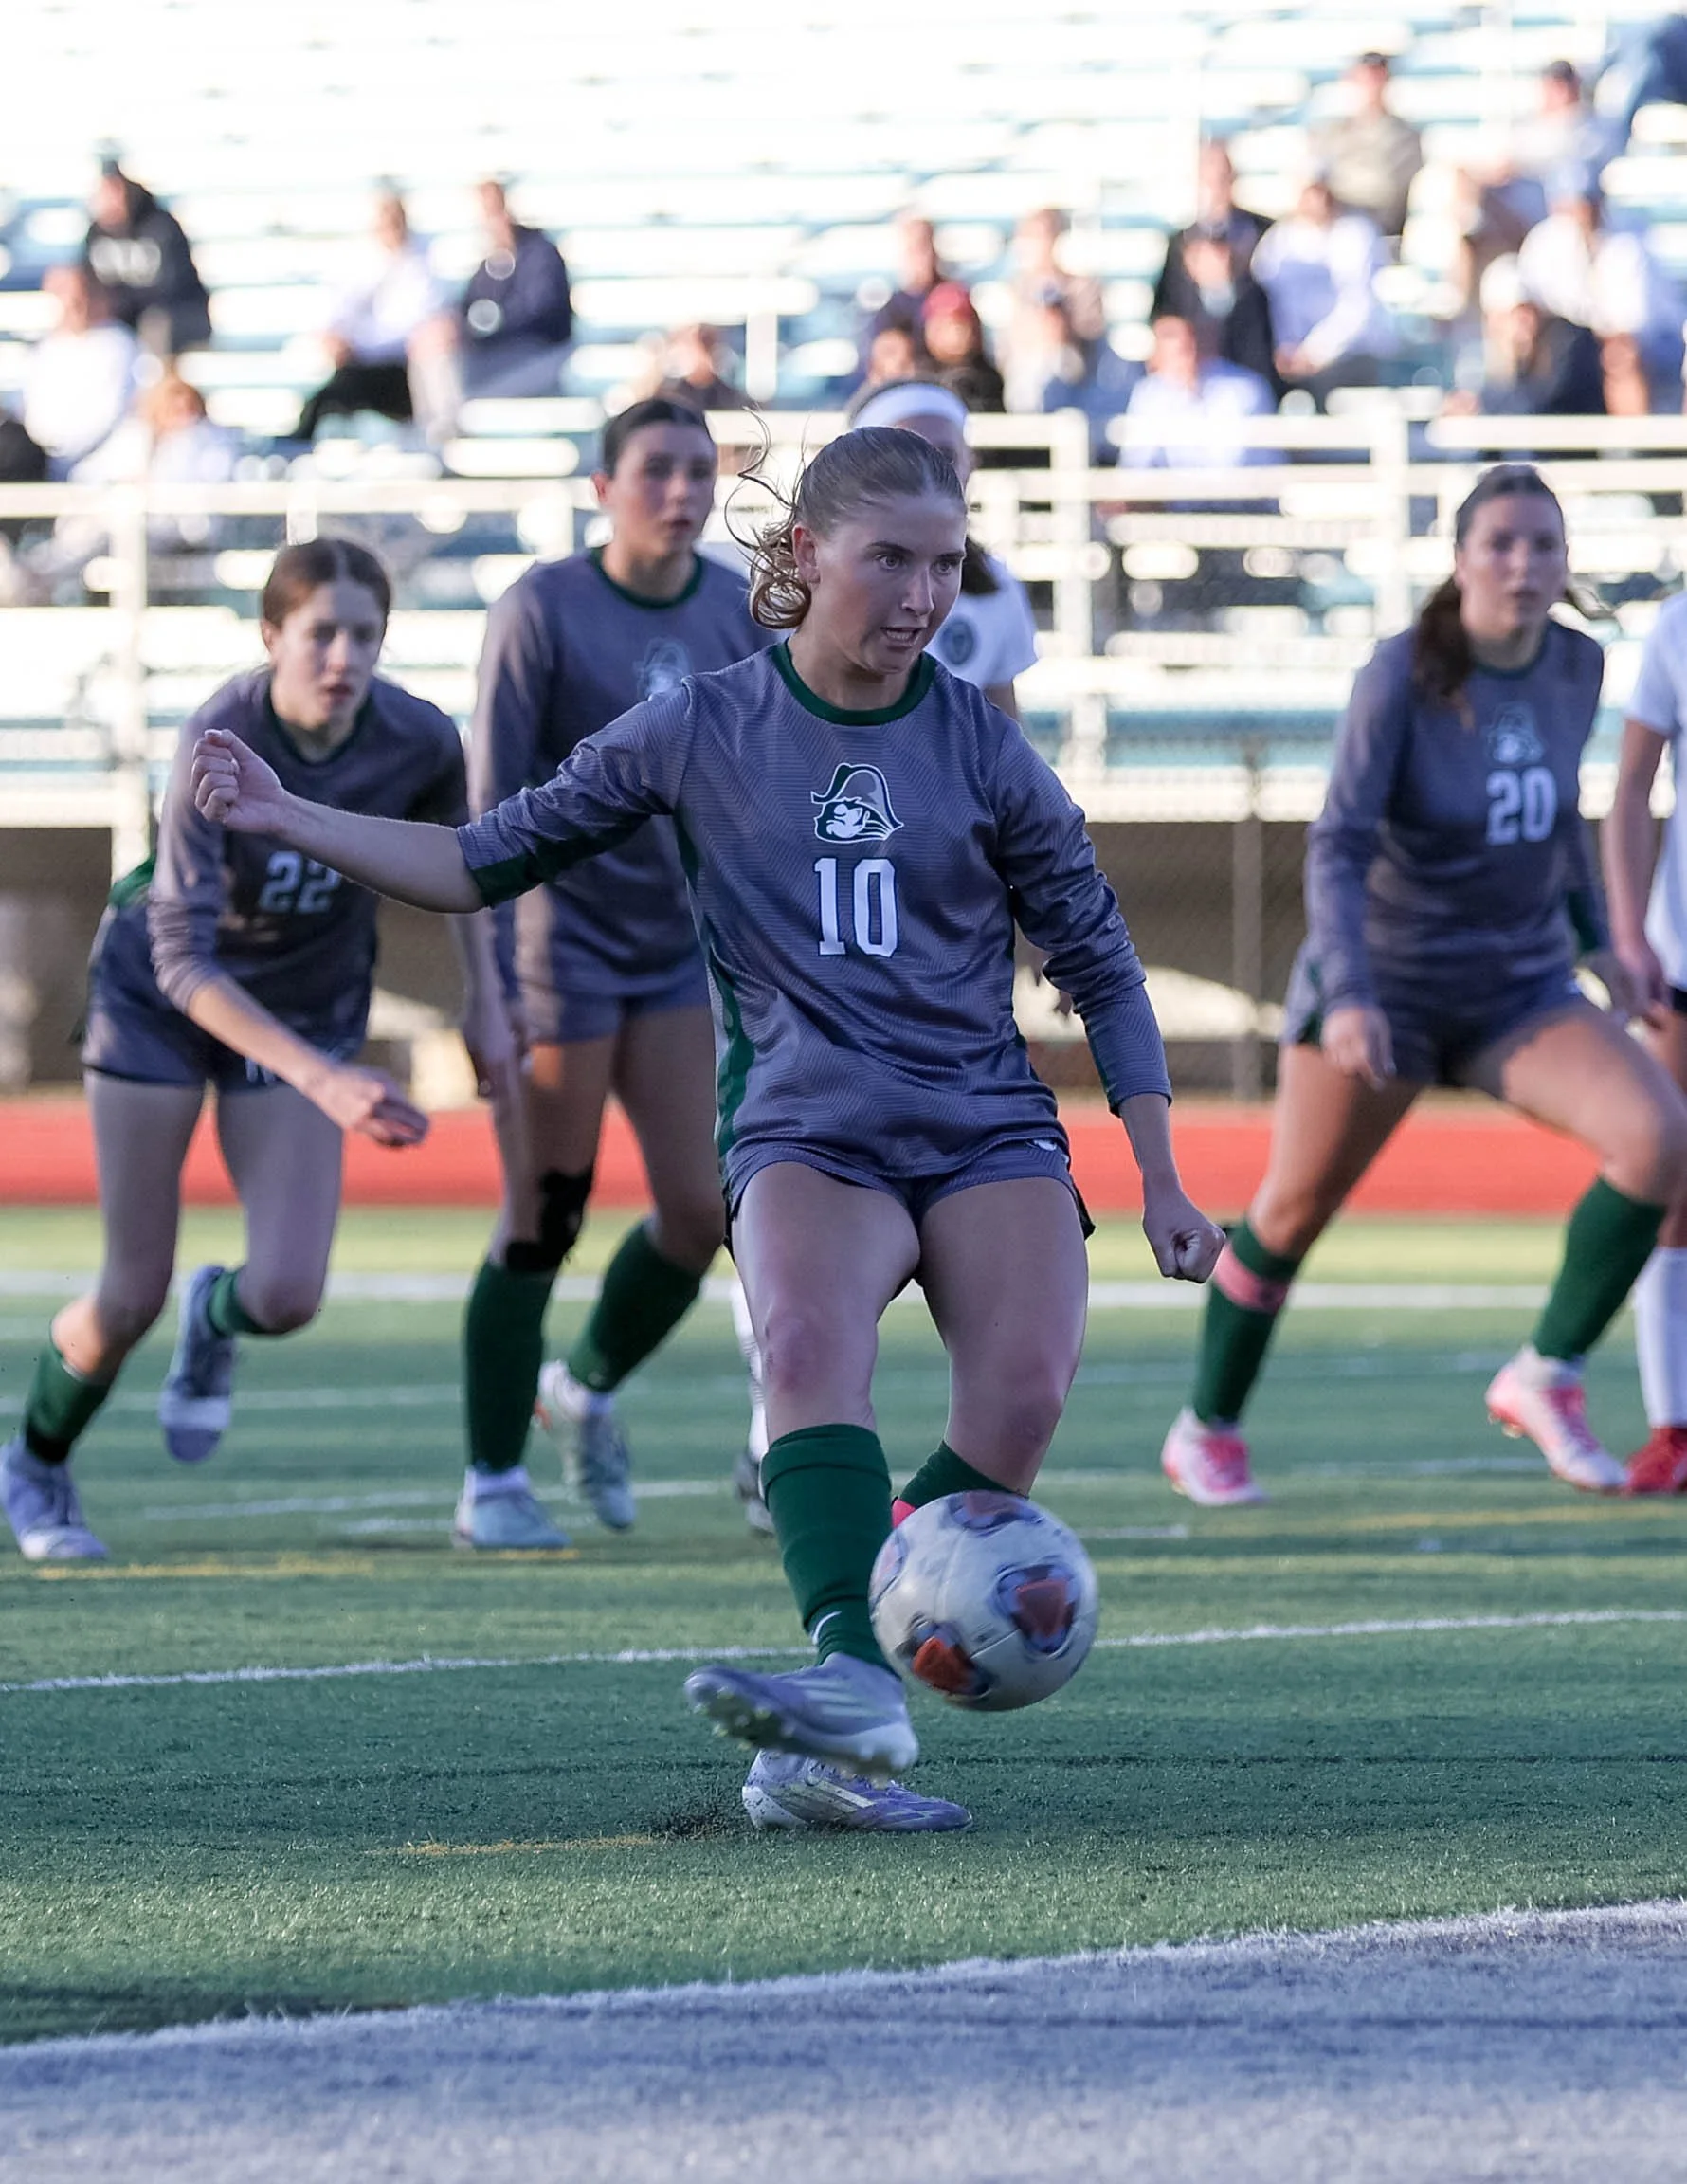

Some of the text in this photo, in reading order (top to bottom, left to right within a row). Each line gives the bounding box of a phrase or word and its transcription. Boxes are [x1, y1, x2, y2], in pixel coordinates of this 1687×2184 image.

[1485, 766, 1557, 846] 20
[258, 850, 341, 912] 22
[813, 857, 898, 957] 10
